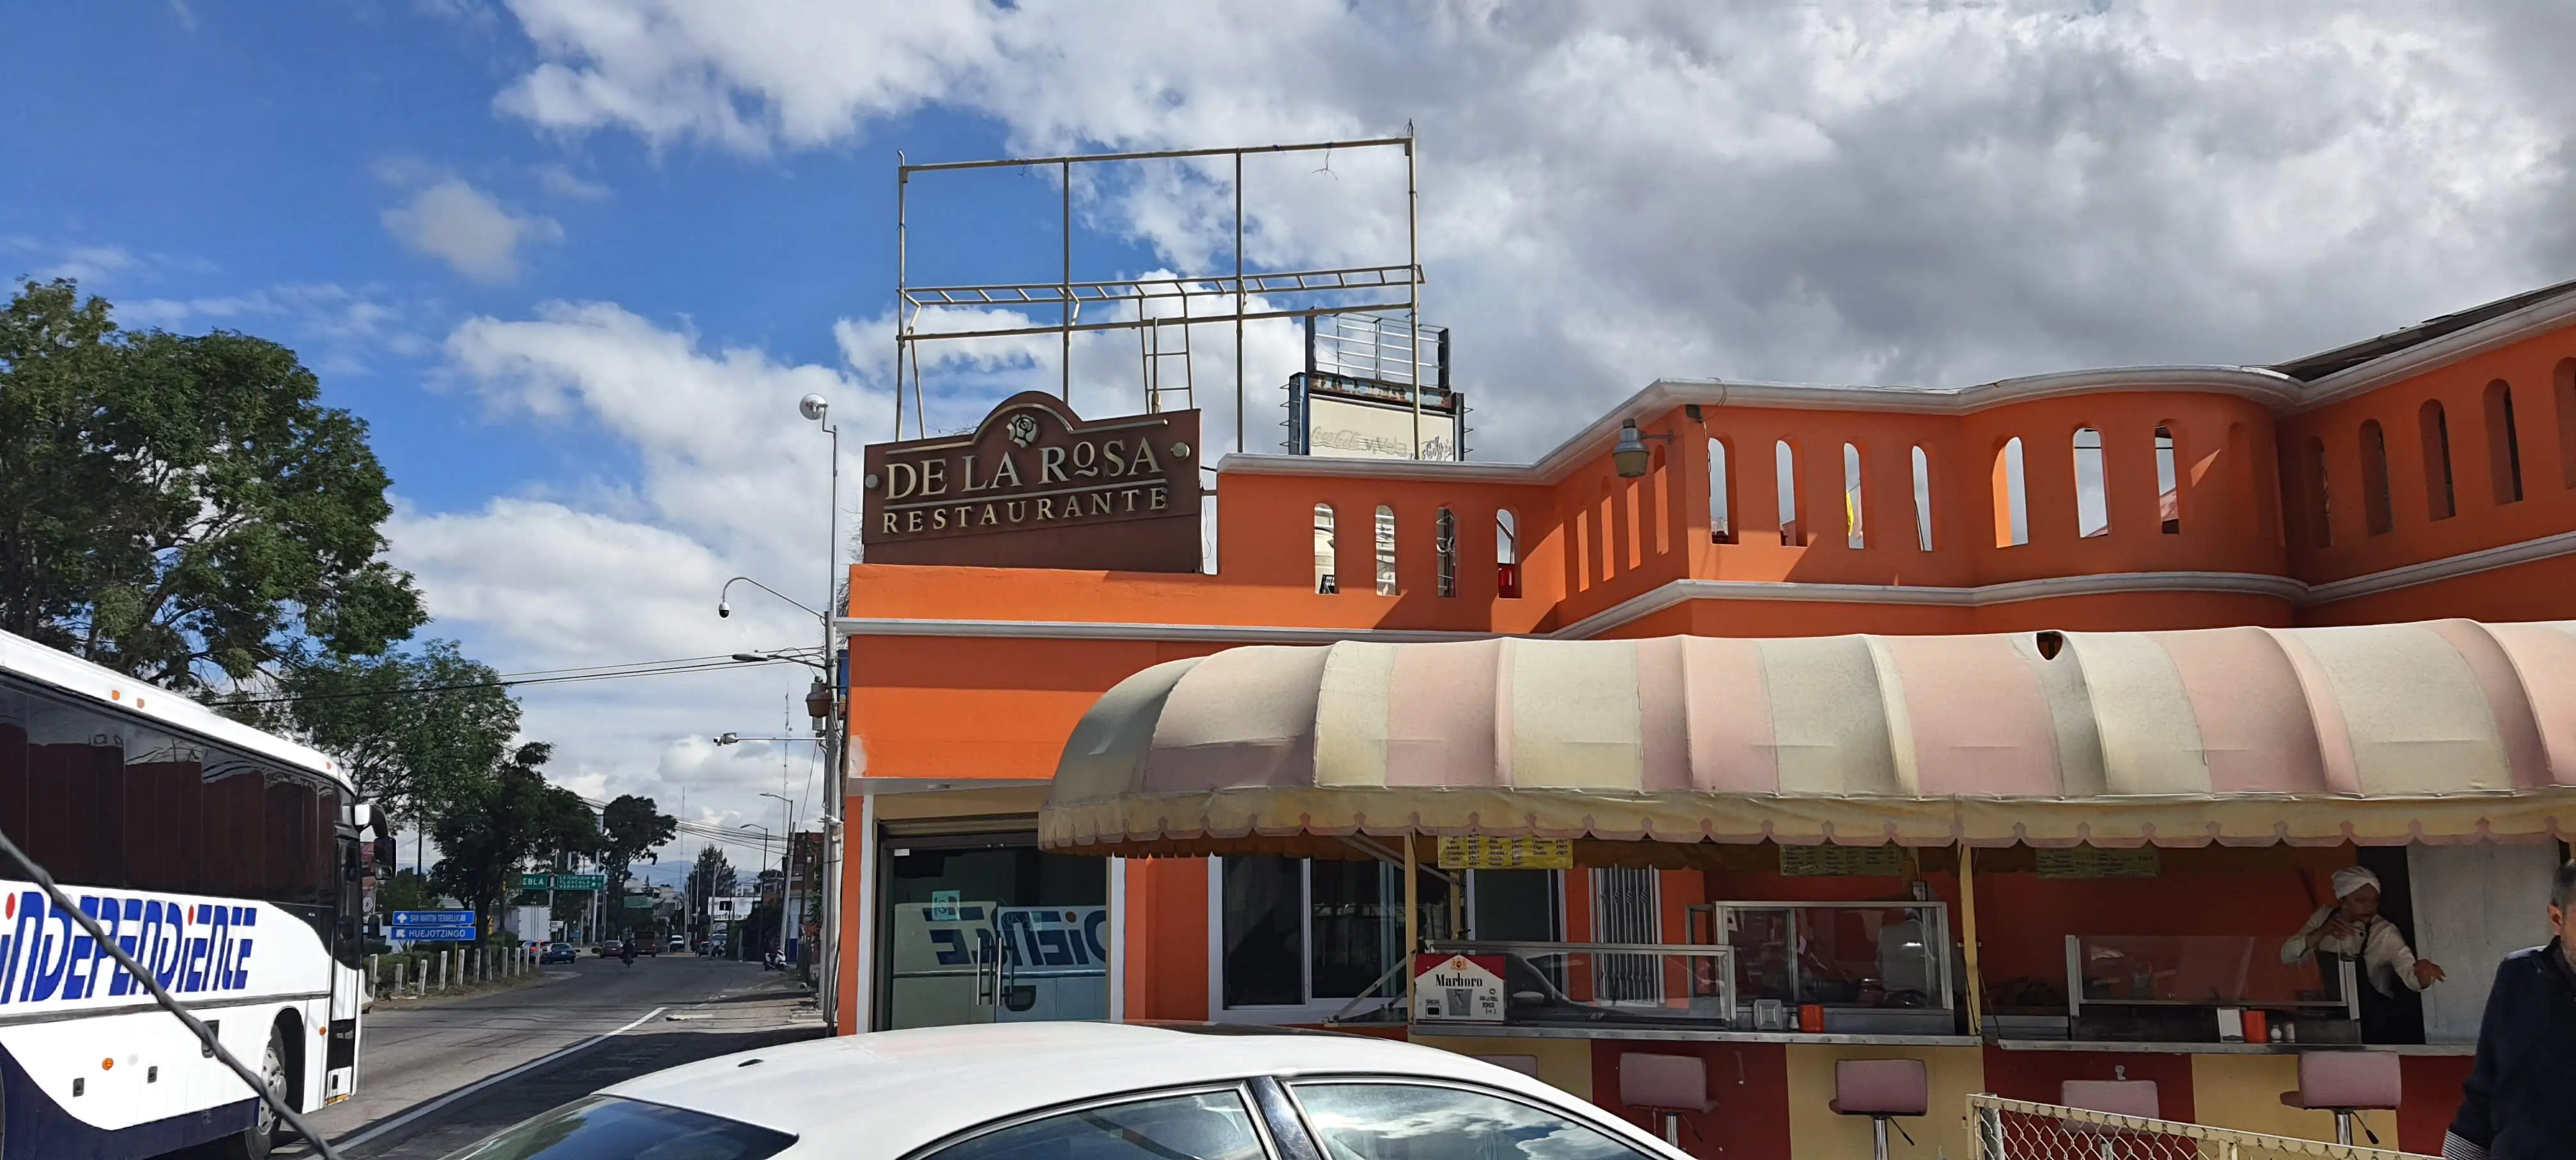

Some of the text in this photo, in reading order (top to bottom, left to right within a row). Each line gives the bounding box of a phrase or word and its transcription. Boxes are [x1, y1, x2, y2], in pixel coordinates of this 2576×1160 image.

[884, 437, 1164, 501] DE LA ROSA
[882, 487, 1169, 533] RESTAURANTE
[408, 929, 466, 938] HUEJOTZINGO
